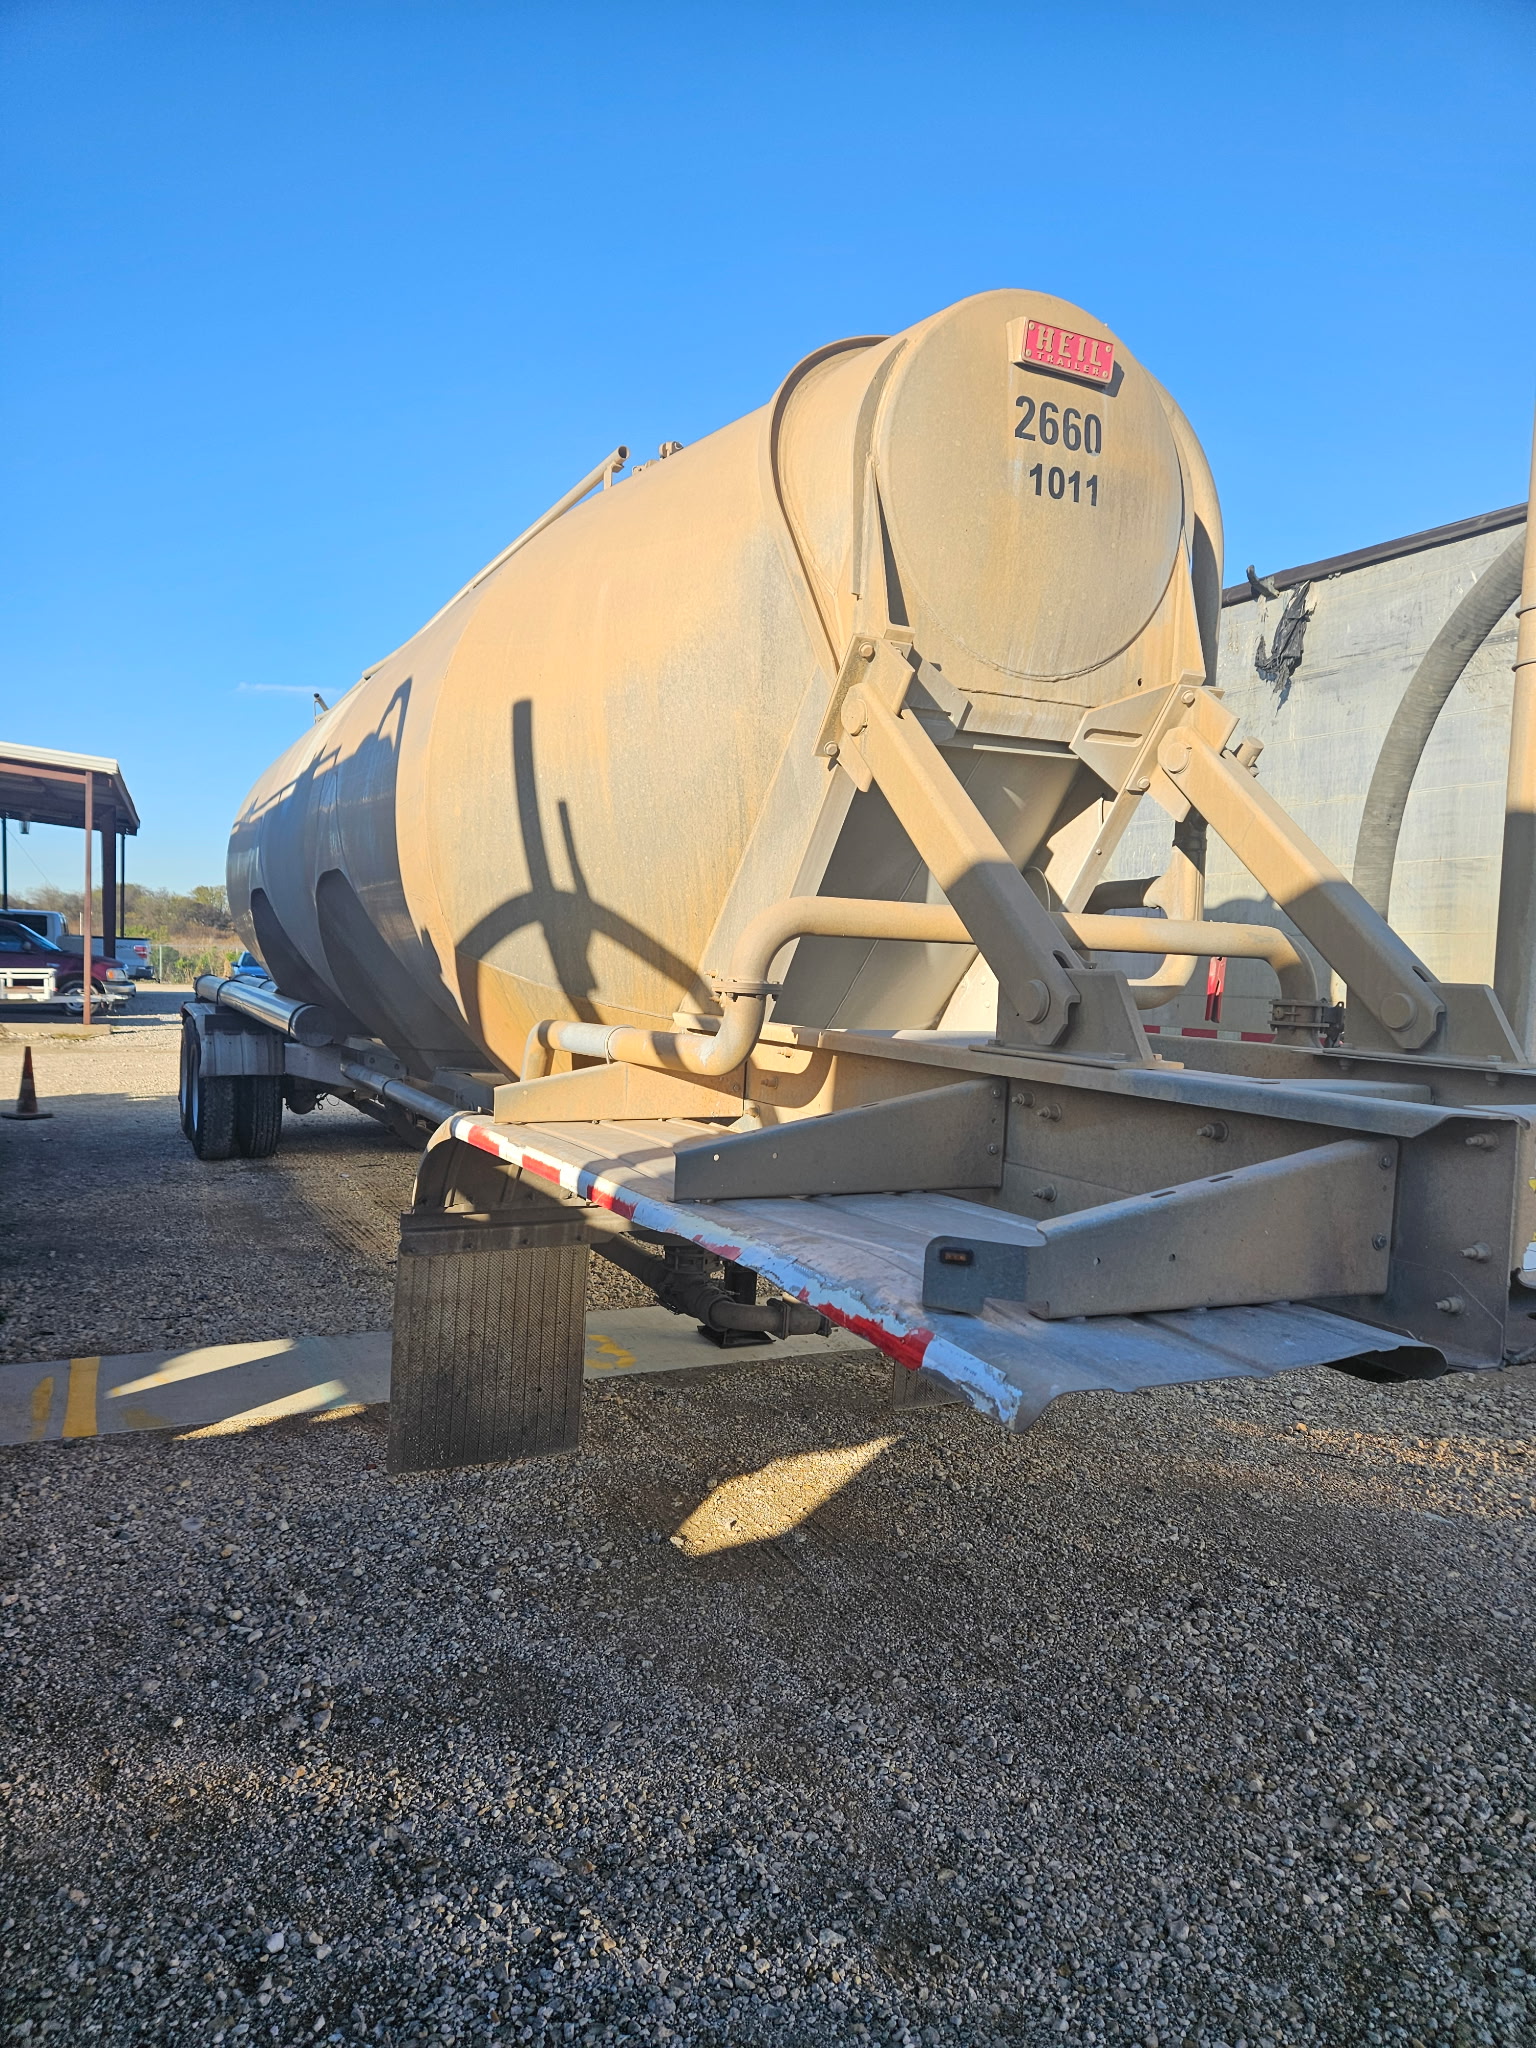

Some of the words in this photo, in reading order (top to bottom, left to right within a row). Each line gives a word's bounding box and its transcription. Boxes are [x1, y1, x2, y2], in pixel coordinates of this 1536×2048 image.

[1036, 326, 1102, 367] HEIL
[1037, 352, 1099, 376] TRAILER
[1014, 395, 1102, 457] 2660
[1029, 462, 1098, 507] 1011
